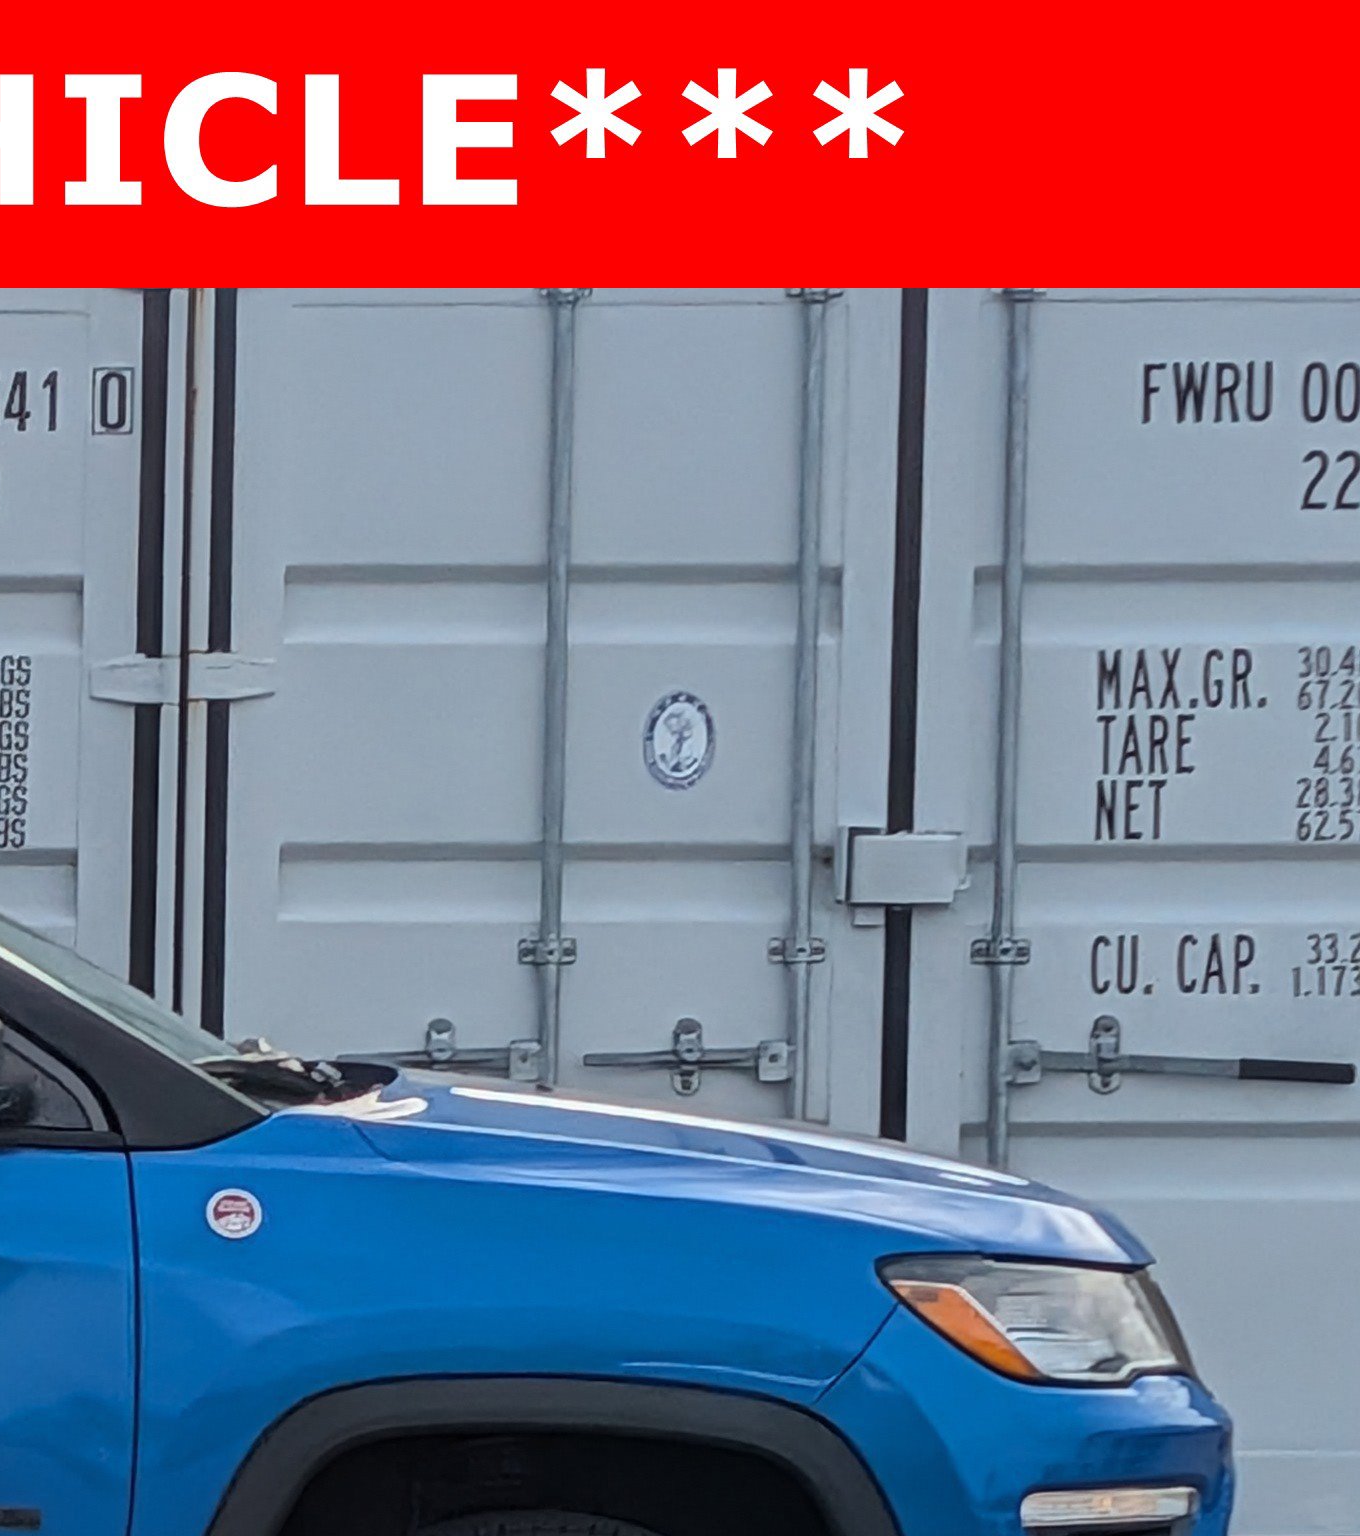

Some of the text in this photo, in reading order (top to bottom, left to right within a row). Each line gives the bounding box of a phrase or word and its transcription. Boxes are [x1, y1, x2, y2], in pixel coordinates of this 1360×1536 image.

[100, 371, 127, 429] 0
[1142, 361, 1360, 425] FWRU 00
[1300, 449, 1360, 510] 22
[1297, 645, 1360, 678] 30.4
[1297, 680, 1360, 711] 67.2
[1097, 712, 1360, 775] TARE 2.1
[1313, 745, 1360, 775] 4.6
[1095, 777, 1360, 842] NET 28.3
[1297, 810, 1360, 841] 62.5
[1091, 935, 1154, 995] CU.
[1177, 933, 1261, 995] CAP.
